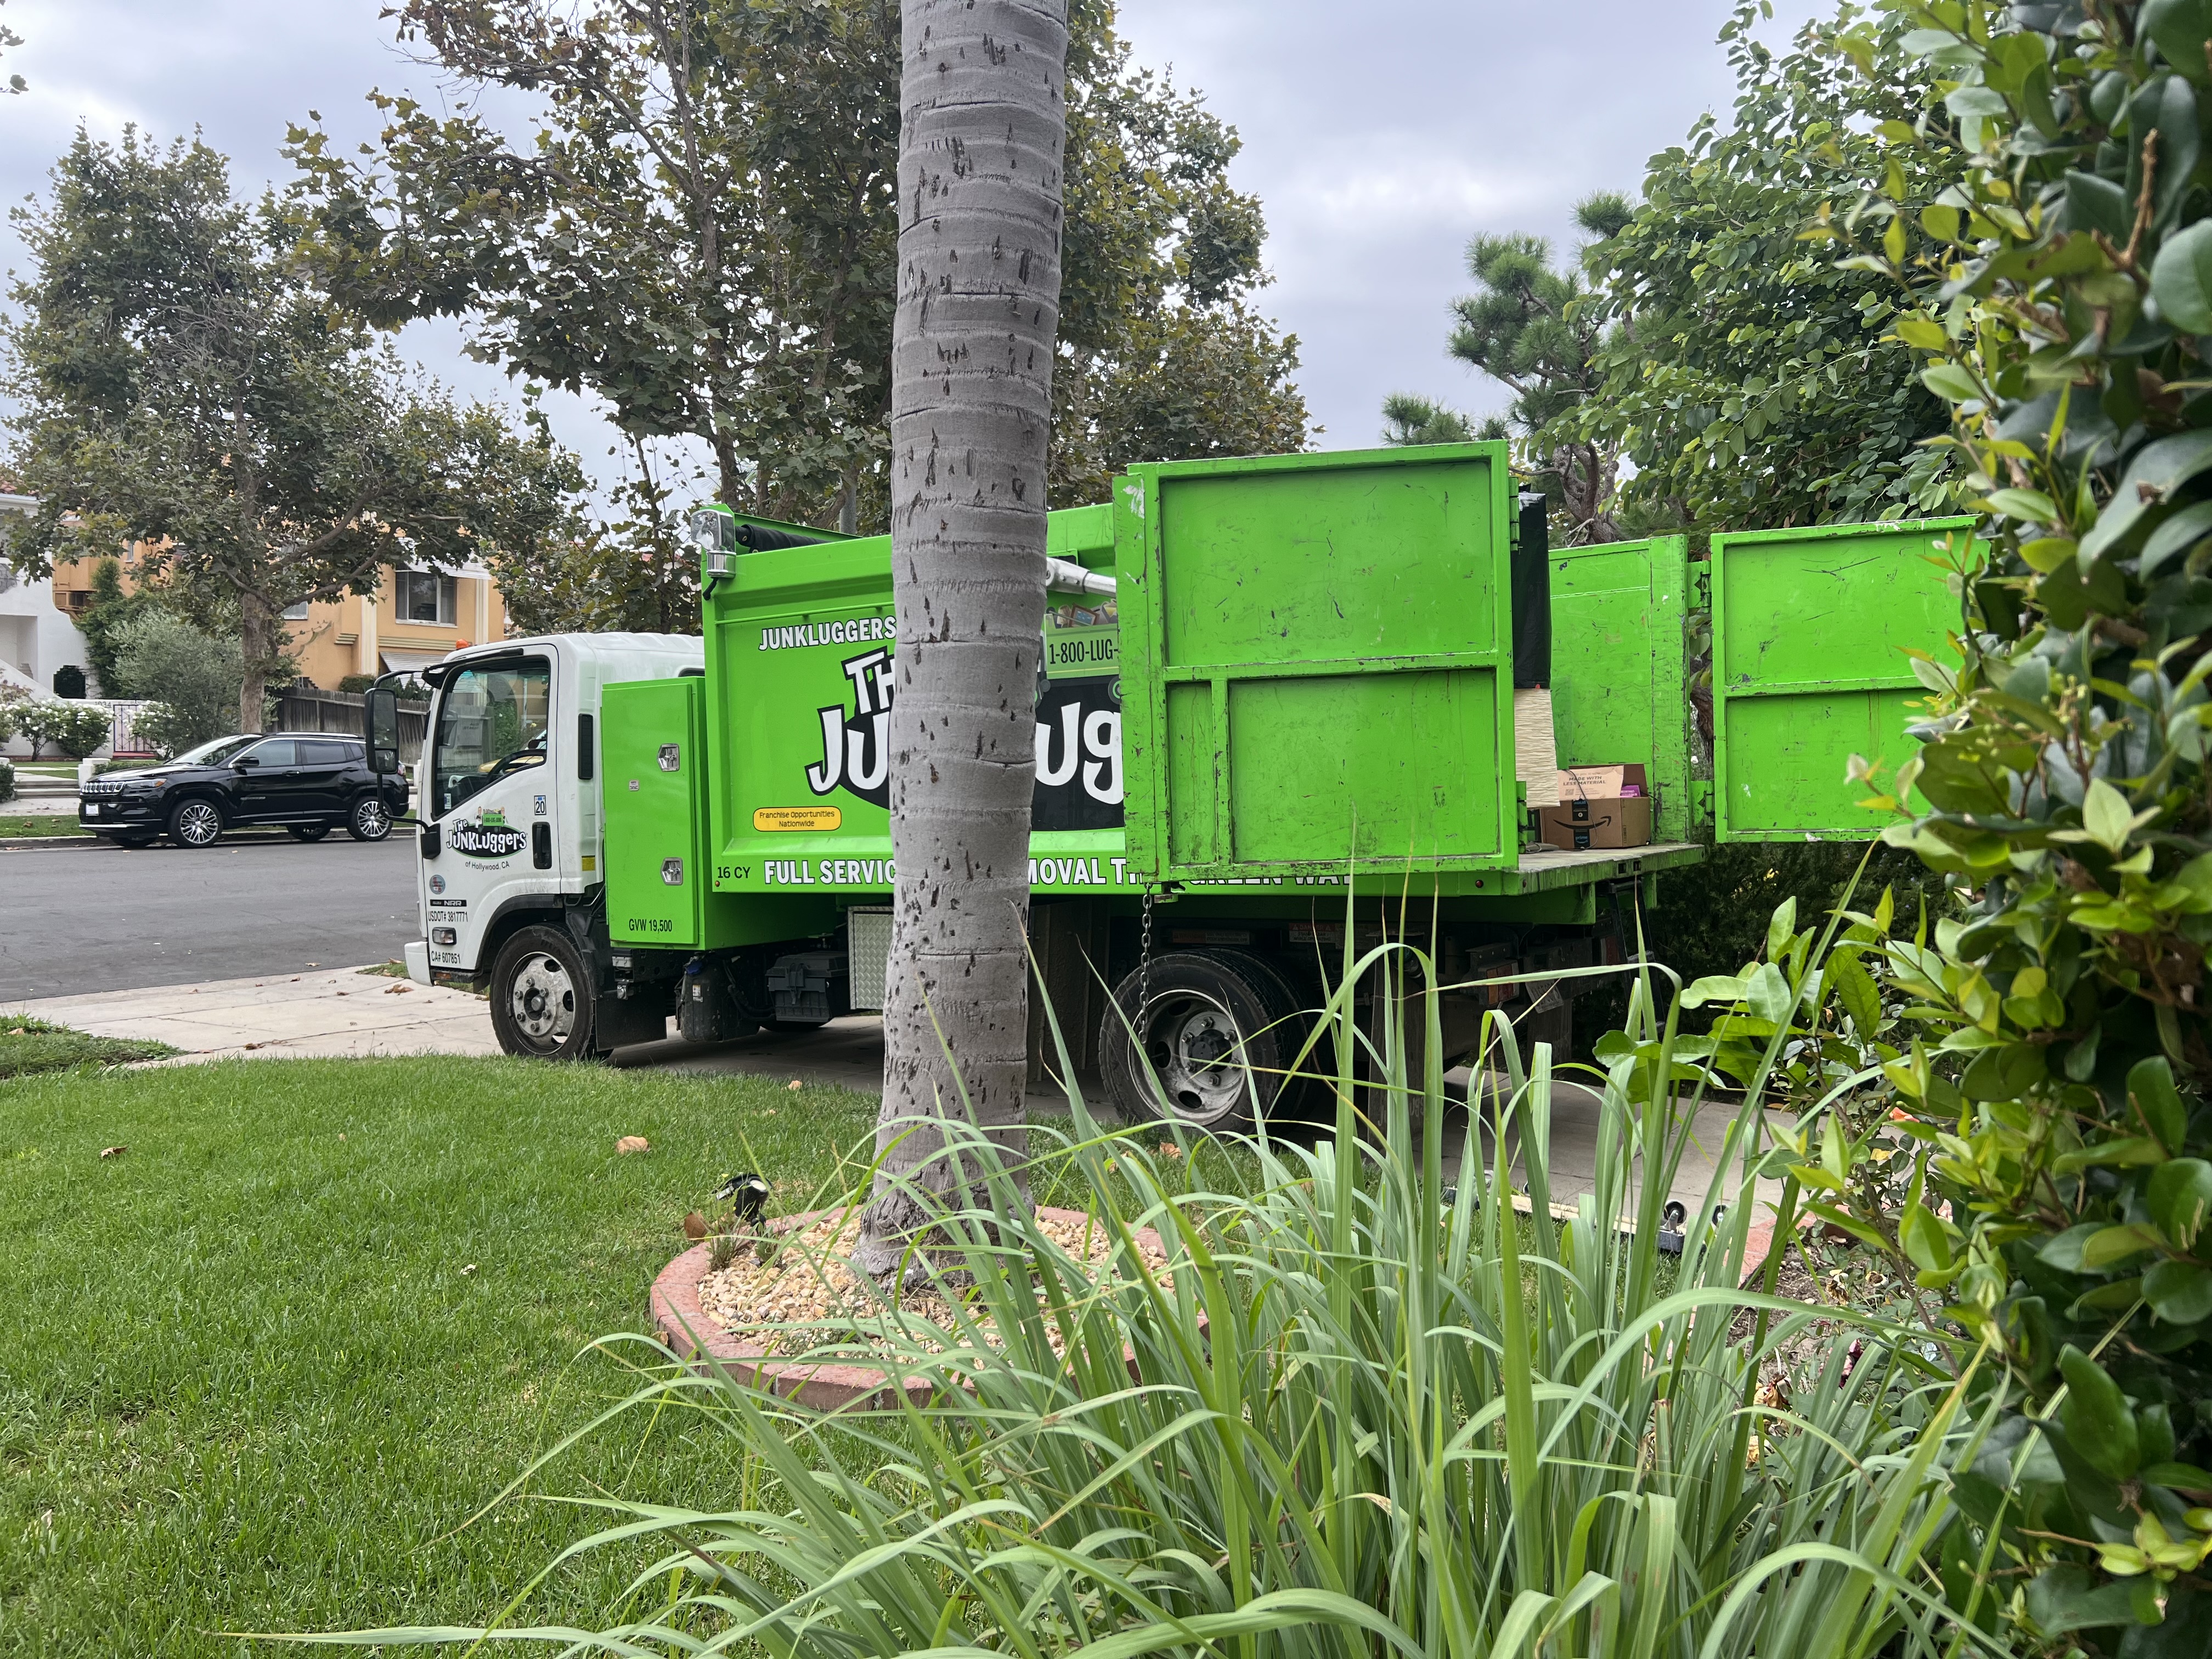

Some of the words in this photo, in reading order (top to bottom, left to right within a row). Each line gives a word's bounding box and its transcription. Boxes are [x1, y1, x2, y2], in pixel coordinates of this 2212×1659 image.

[758, 616, 896, 651] JUNKLUGGERS
[1049, 639, 1119, 664] 1-800-LUG-
[843, 648, 895, 715] TH
[535, 801, 545, 813] 20
[791, 811, 834, 819] Opportunities
[718, 867, 731, 878] 16
[734, 866, 751, 879] CY
[764, 860, 815, 884] FULL
[819, 859, 895, 884] SERVIC
[428, 911, 446, 922] USDOT#
[629, 919, 646, 932] GVW
[649, 919, 673, 933] 19,500
[431, 951, 441, 962] CA#
[442, 952, 461, 964] 607851
